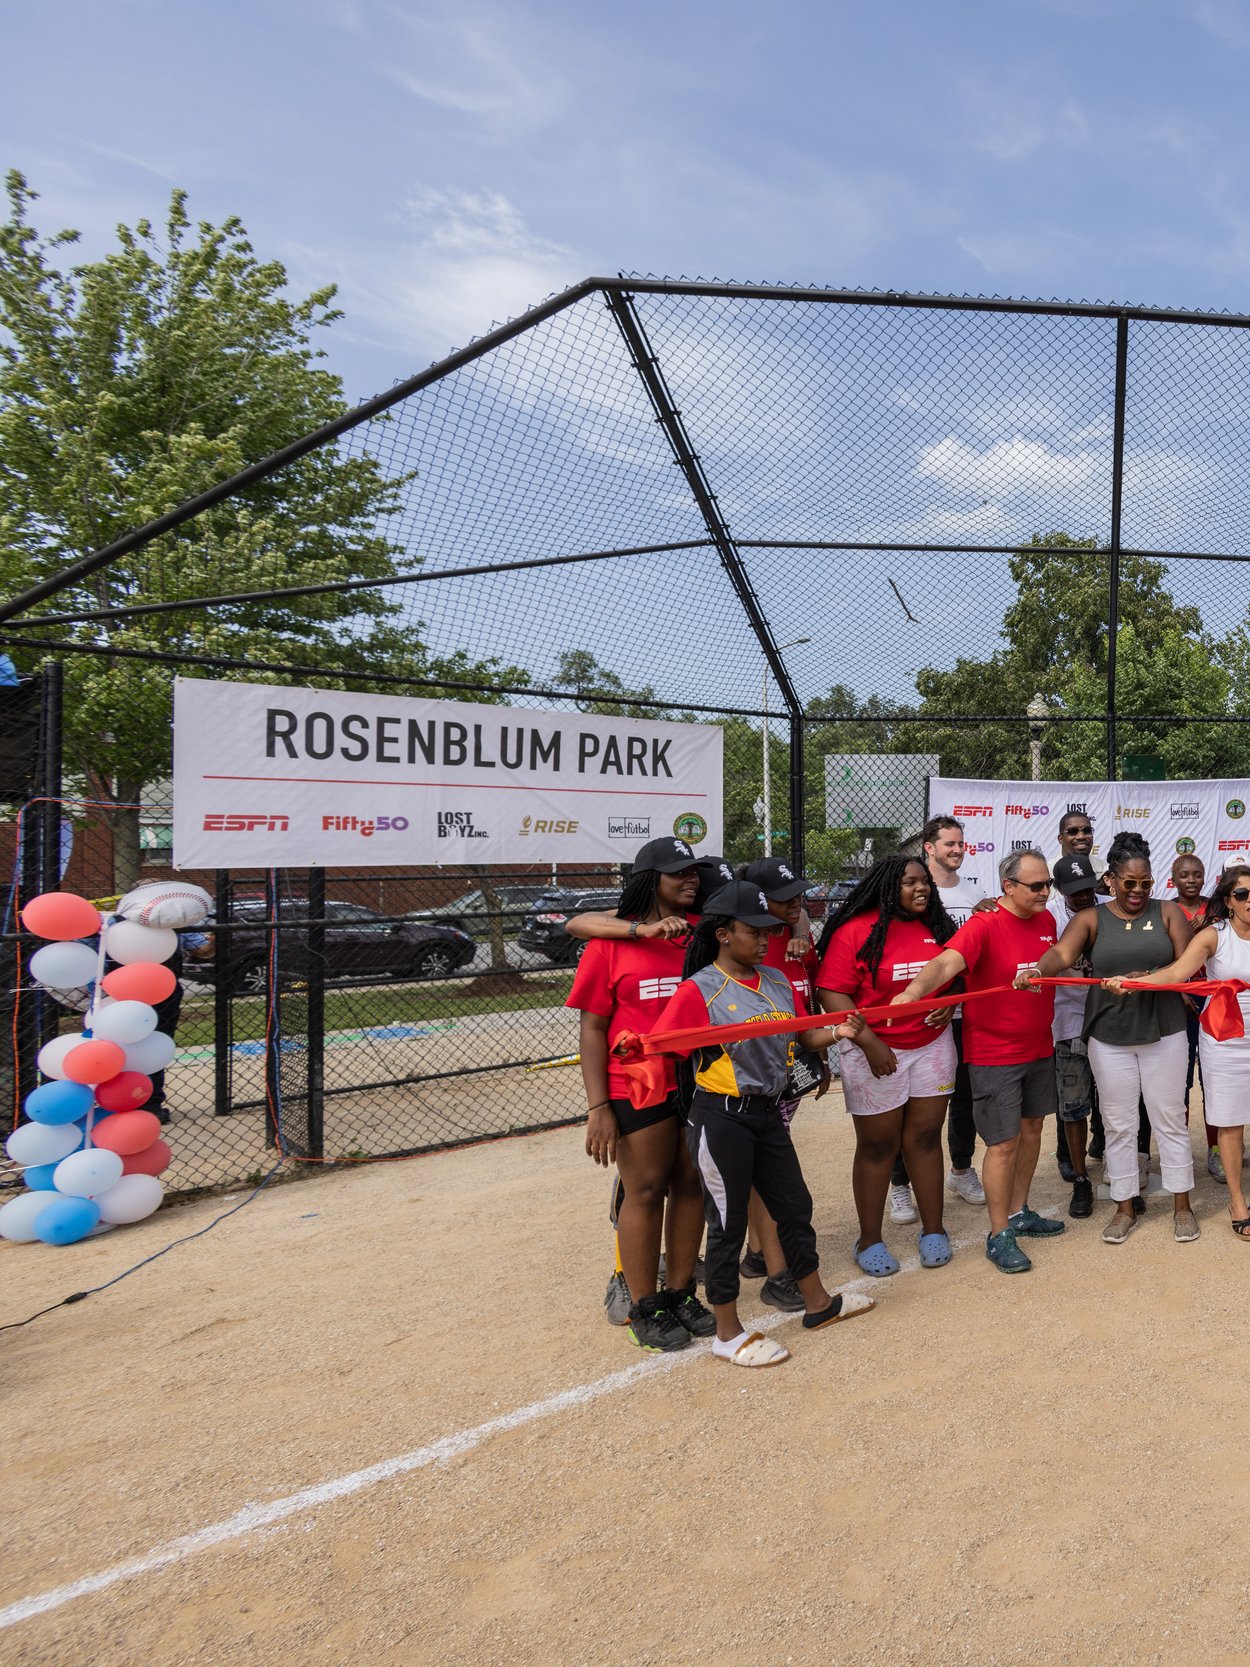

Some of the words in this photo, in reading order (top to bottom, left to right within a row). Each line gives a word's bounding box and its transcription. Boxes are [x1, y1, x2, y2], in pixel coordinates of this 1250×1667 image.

[265, 707, 562, 772] ROSENBLUM
[578, 733, 674, 778] PARK
[437, 811, 473, 825] LOST
[953, 805, 993, 817] ESPN
[1122, 808, 1151, 819] RISE
[203, 814, 289, 831] ESPN
[321, 815, 409, 837] Fifty50
[534, 820, 580, 834] RISE
